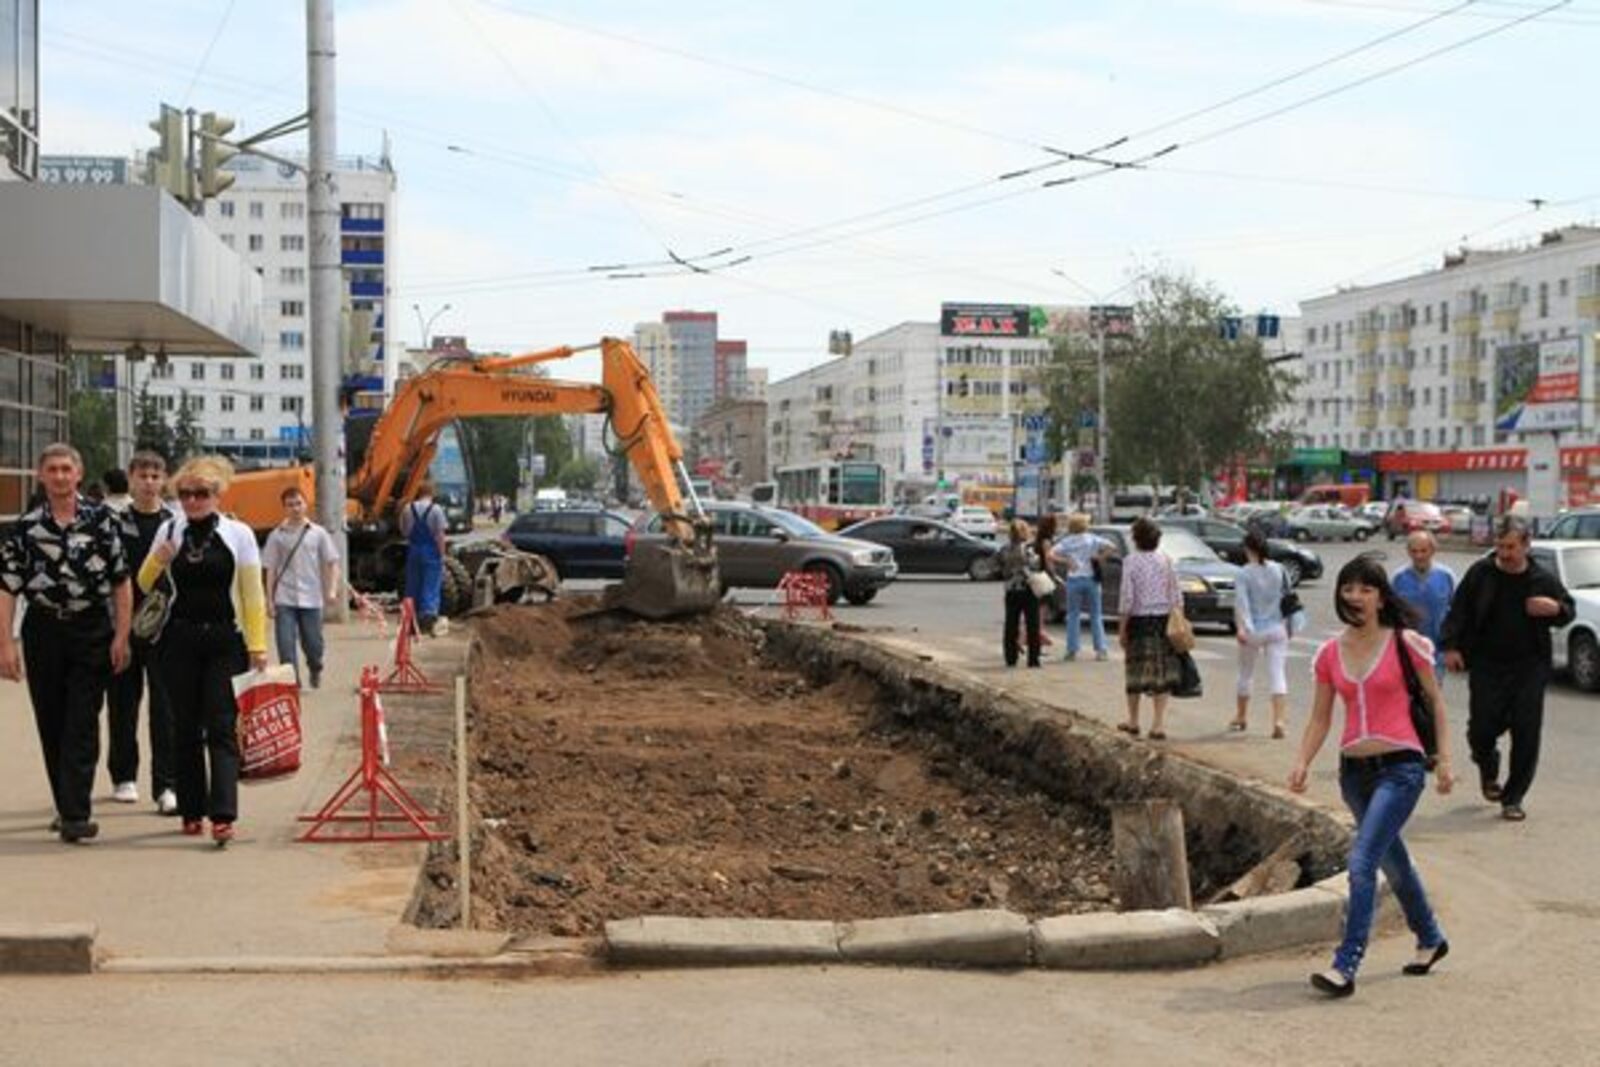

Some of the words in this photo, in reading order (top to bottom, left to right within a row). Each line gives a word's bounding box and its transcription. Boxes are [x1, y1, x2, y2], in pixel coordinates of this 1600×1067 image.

[64, 167, 87, 183] 99
[91, 167, 114, 183] 99
[501, 389, 556, 402] HYUNDAI
